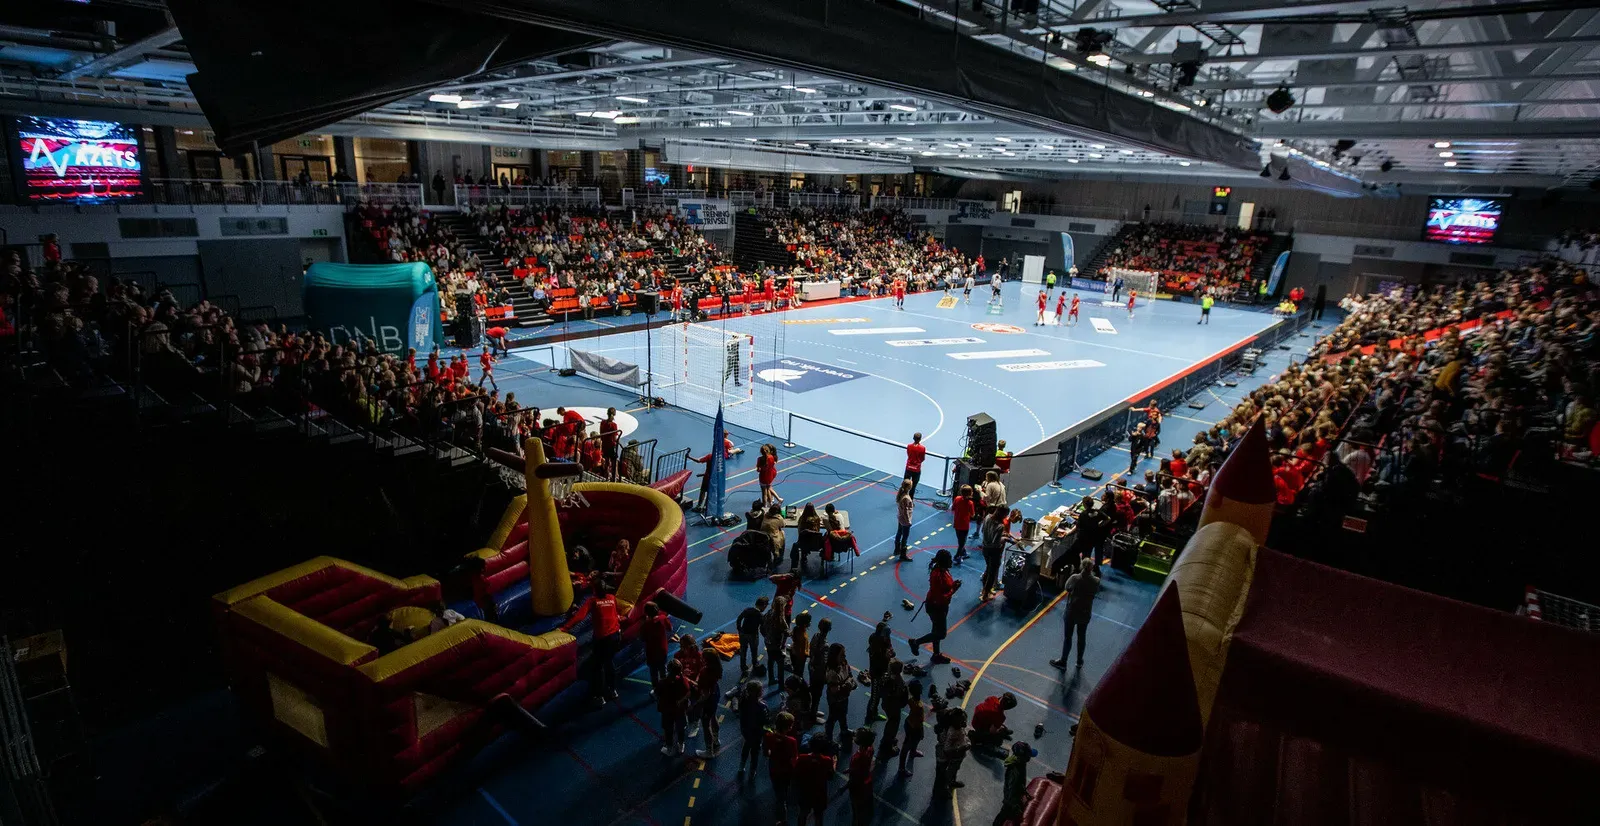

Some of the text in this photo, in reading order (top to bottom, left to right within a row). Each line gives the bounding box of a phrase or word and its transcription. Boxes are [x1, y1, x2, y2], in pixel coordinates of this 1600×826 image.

[75, 143, 136, 167] AZETS
[703, 217, 728, 225] TRIVSEL
[330, 315, 403, 354] DNB
